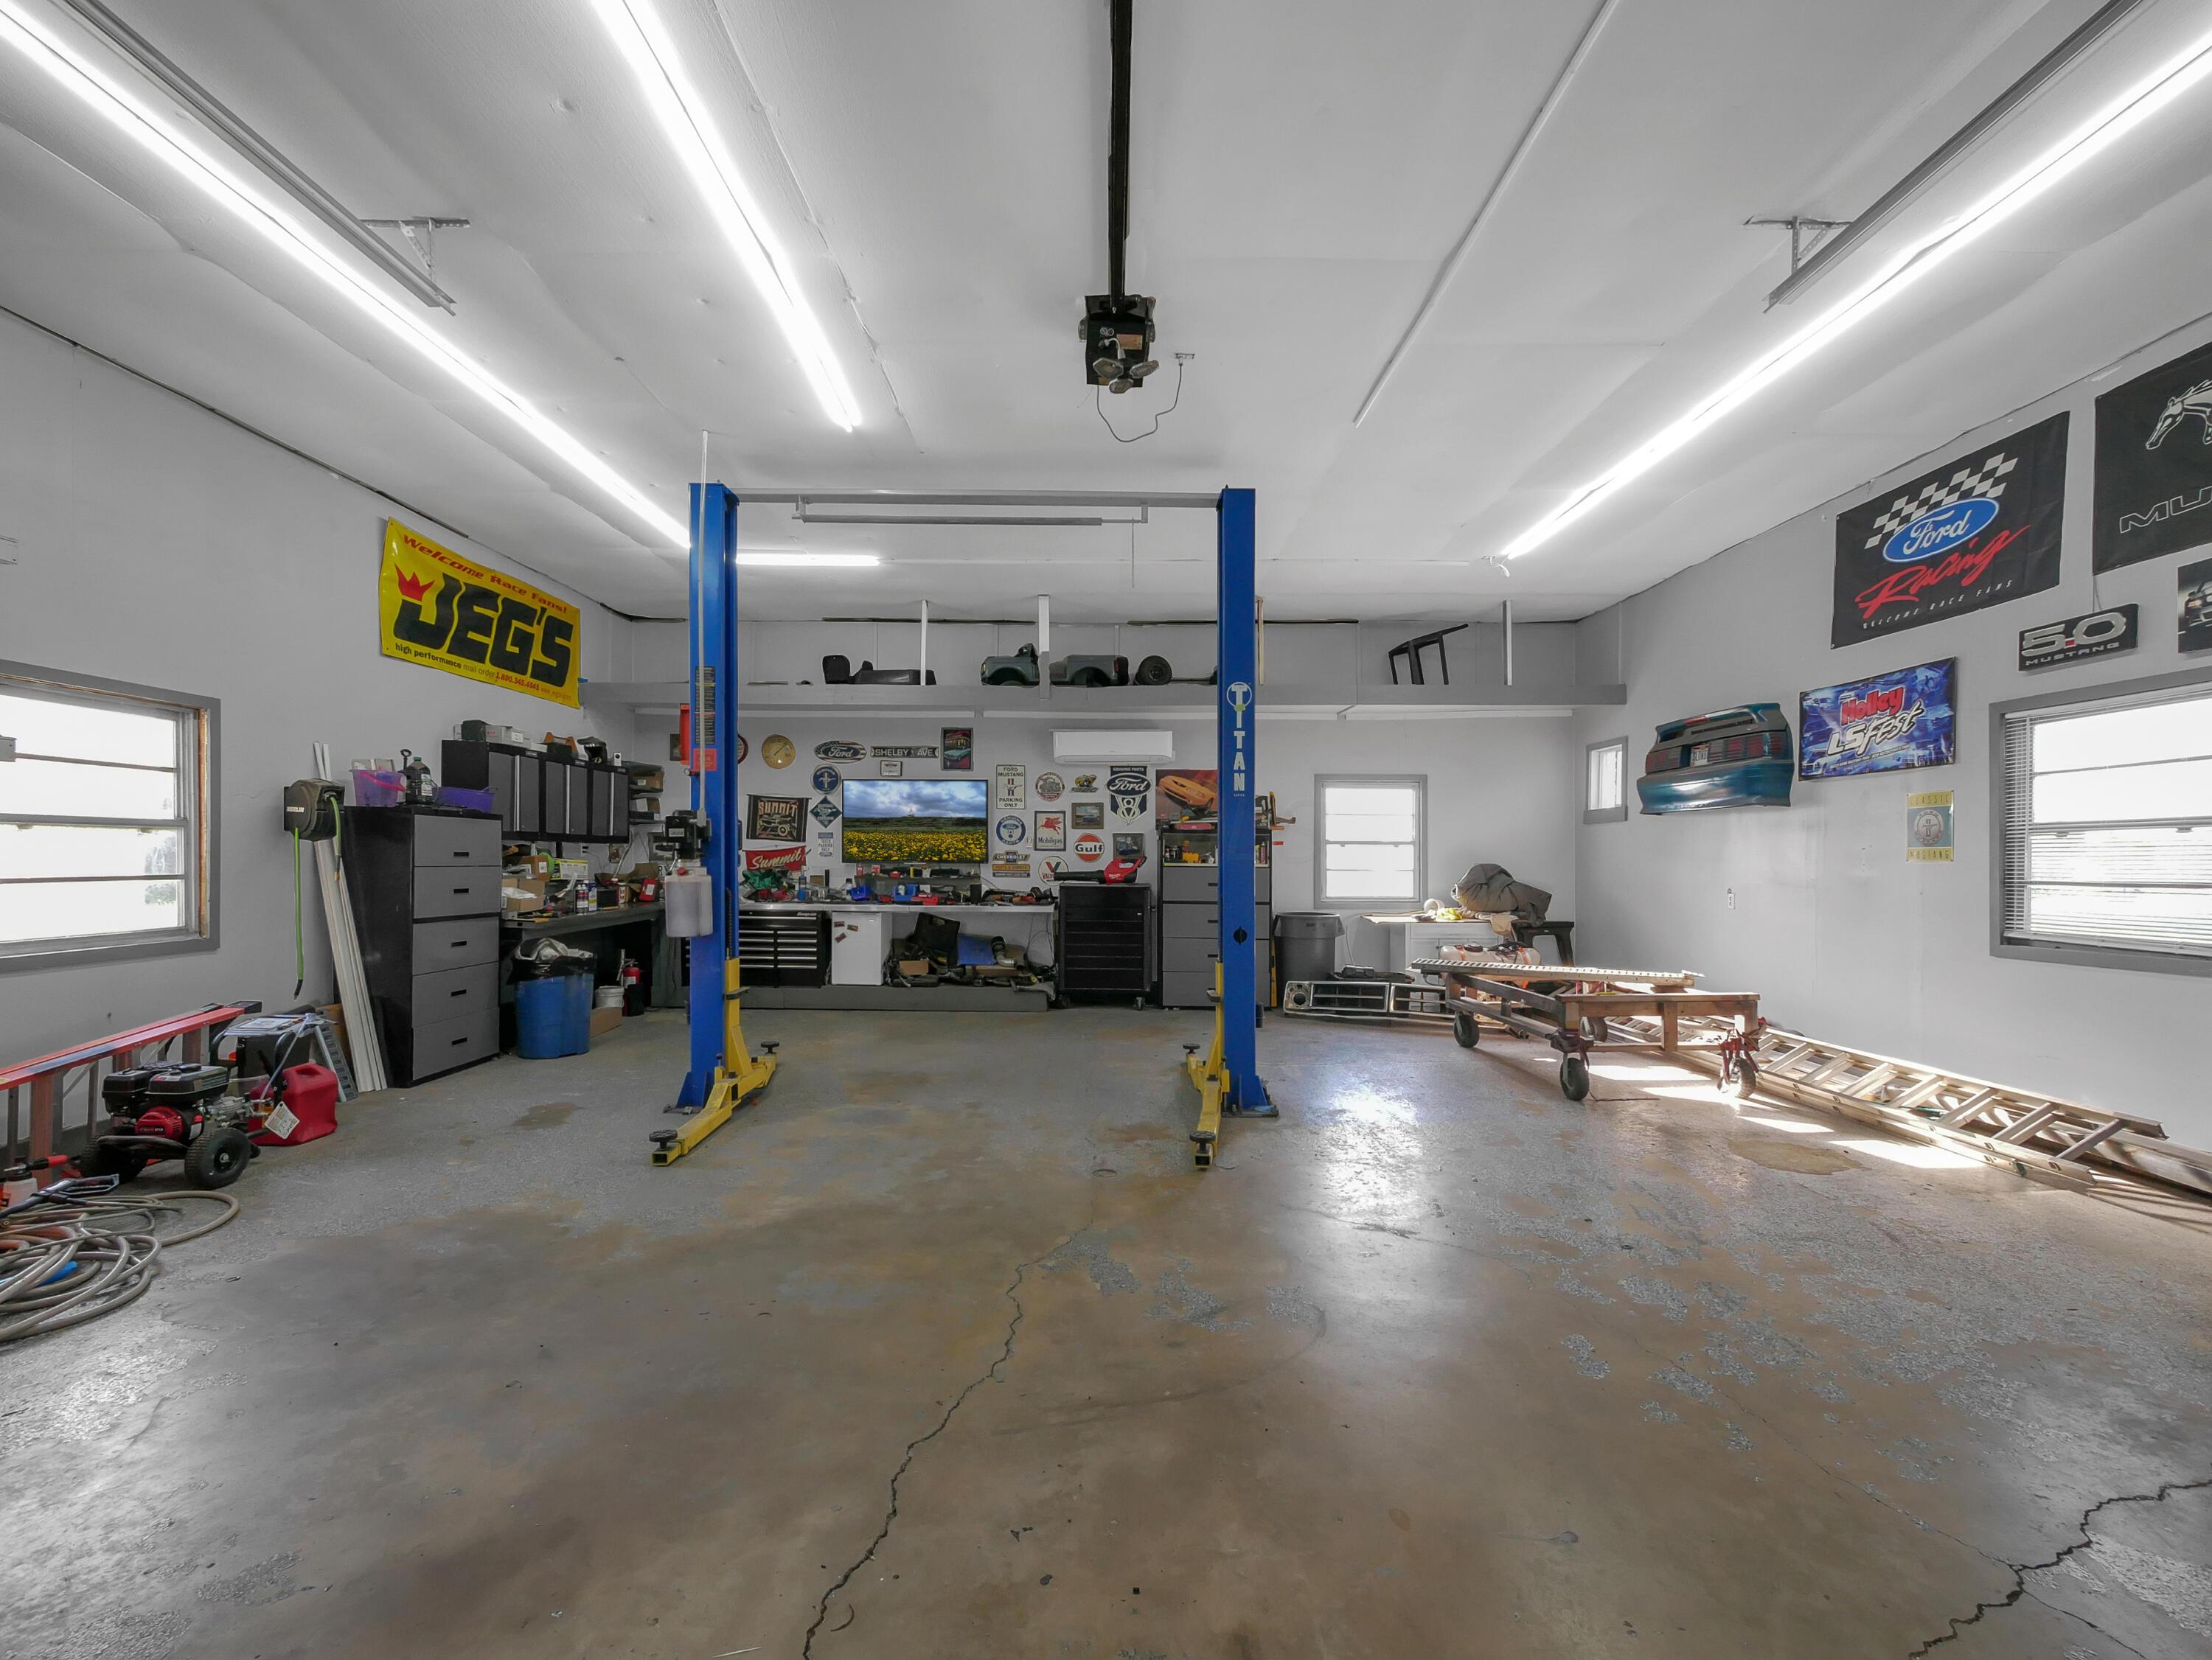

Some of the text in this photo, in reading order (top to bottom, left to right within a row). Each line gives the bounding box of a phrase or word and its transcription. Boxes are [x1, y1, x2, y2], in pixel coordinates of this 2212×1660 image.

[1903, 509, 1972, 554] Ford
[403, 534, 567, 613] Welcome Race Fans!
[1854, 525, 2031, 618] Racing
[1863, 579, 2012, 629] WELCOME RACE FANS
[2021, 612, 2126, 657] 5.0
[395, 643, 411, 655] high
[414, 649, 462, 669] performance
[463, 663, 476, 673] mail
[479, 668, 495, 678] order
[2025, 641, 2120, 666] MUSTANG
[1841, 687, 1904, 726] Holley
[828, 746, 854, 758] Ford
[875, 748, 908, 756] SHELBY
[1231, 685, 1248, 791] TITAN
[1109, 777, 1148, 791] Ford
[758, 801, 798, 817] SUMMIT
[749, 848, 801, 870] Summit
[1075, 843, 1103, 852] Gulf
[1910, 850, 1950, 859] MUSTANG
